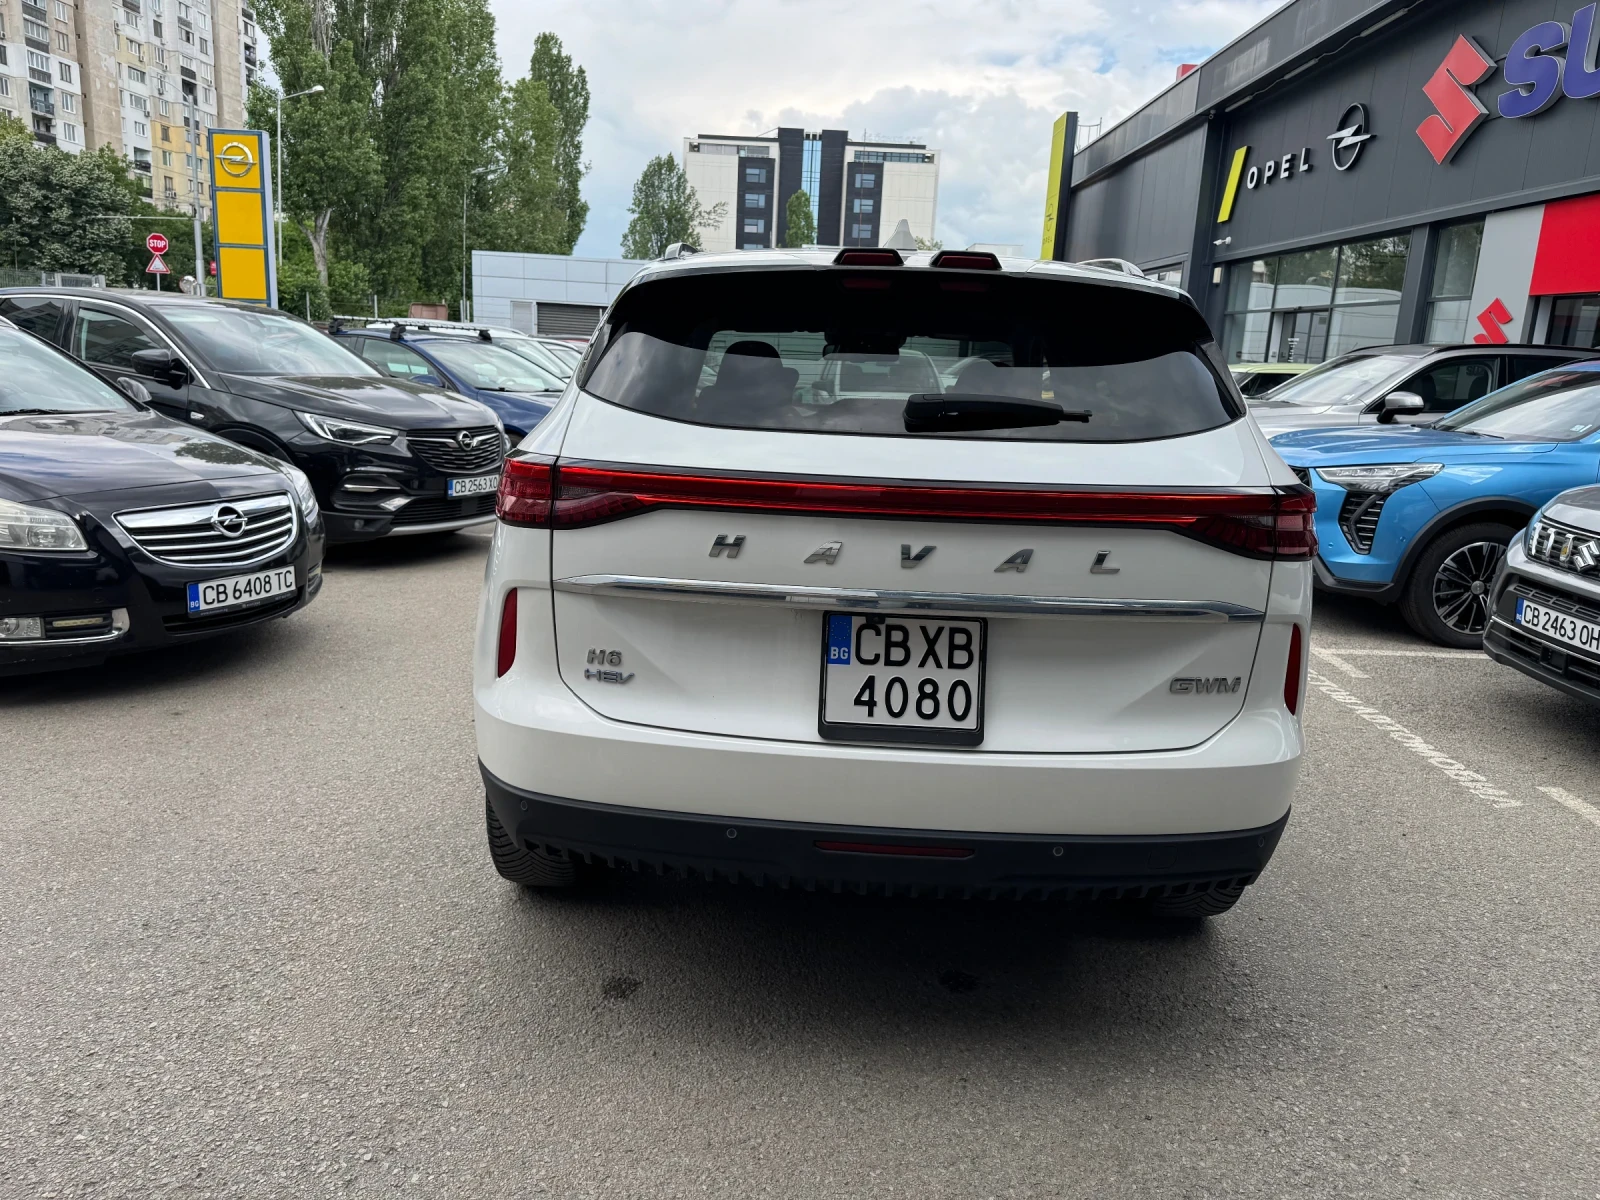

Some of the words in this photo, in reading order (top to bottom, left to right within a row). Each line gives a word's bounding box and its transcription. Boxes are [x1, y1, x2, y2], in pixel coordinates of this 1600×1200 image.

[1247, 147, 1312, 190] OPEL
[149, 239, 166, 248] STOP
[454, 480, 467, 494] CB
[468, 477, 488, 492] 2563
[708, 533, 1121, 575] HAVAL
[203, 583, 228, 605] CB
[232, 574, 272, 600] 6408
[274, 570, 293, 591] TC
[1523, 604, 1540, 627] CB
[1541, 611, 1576, 641] 2463
[586, 648, 622, 666] H6
[830, 646, 849, 659] BG
[855, 623, 911, 666] CB
[917, 625, 974, 669] XB
[584, 668, 635, 684] HEV
[1169, 676, 1242, 694] GWM
[853, 675, 972, 722] 4080
